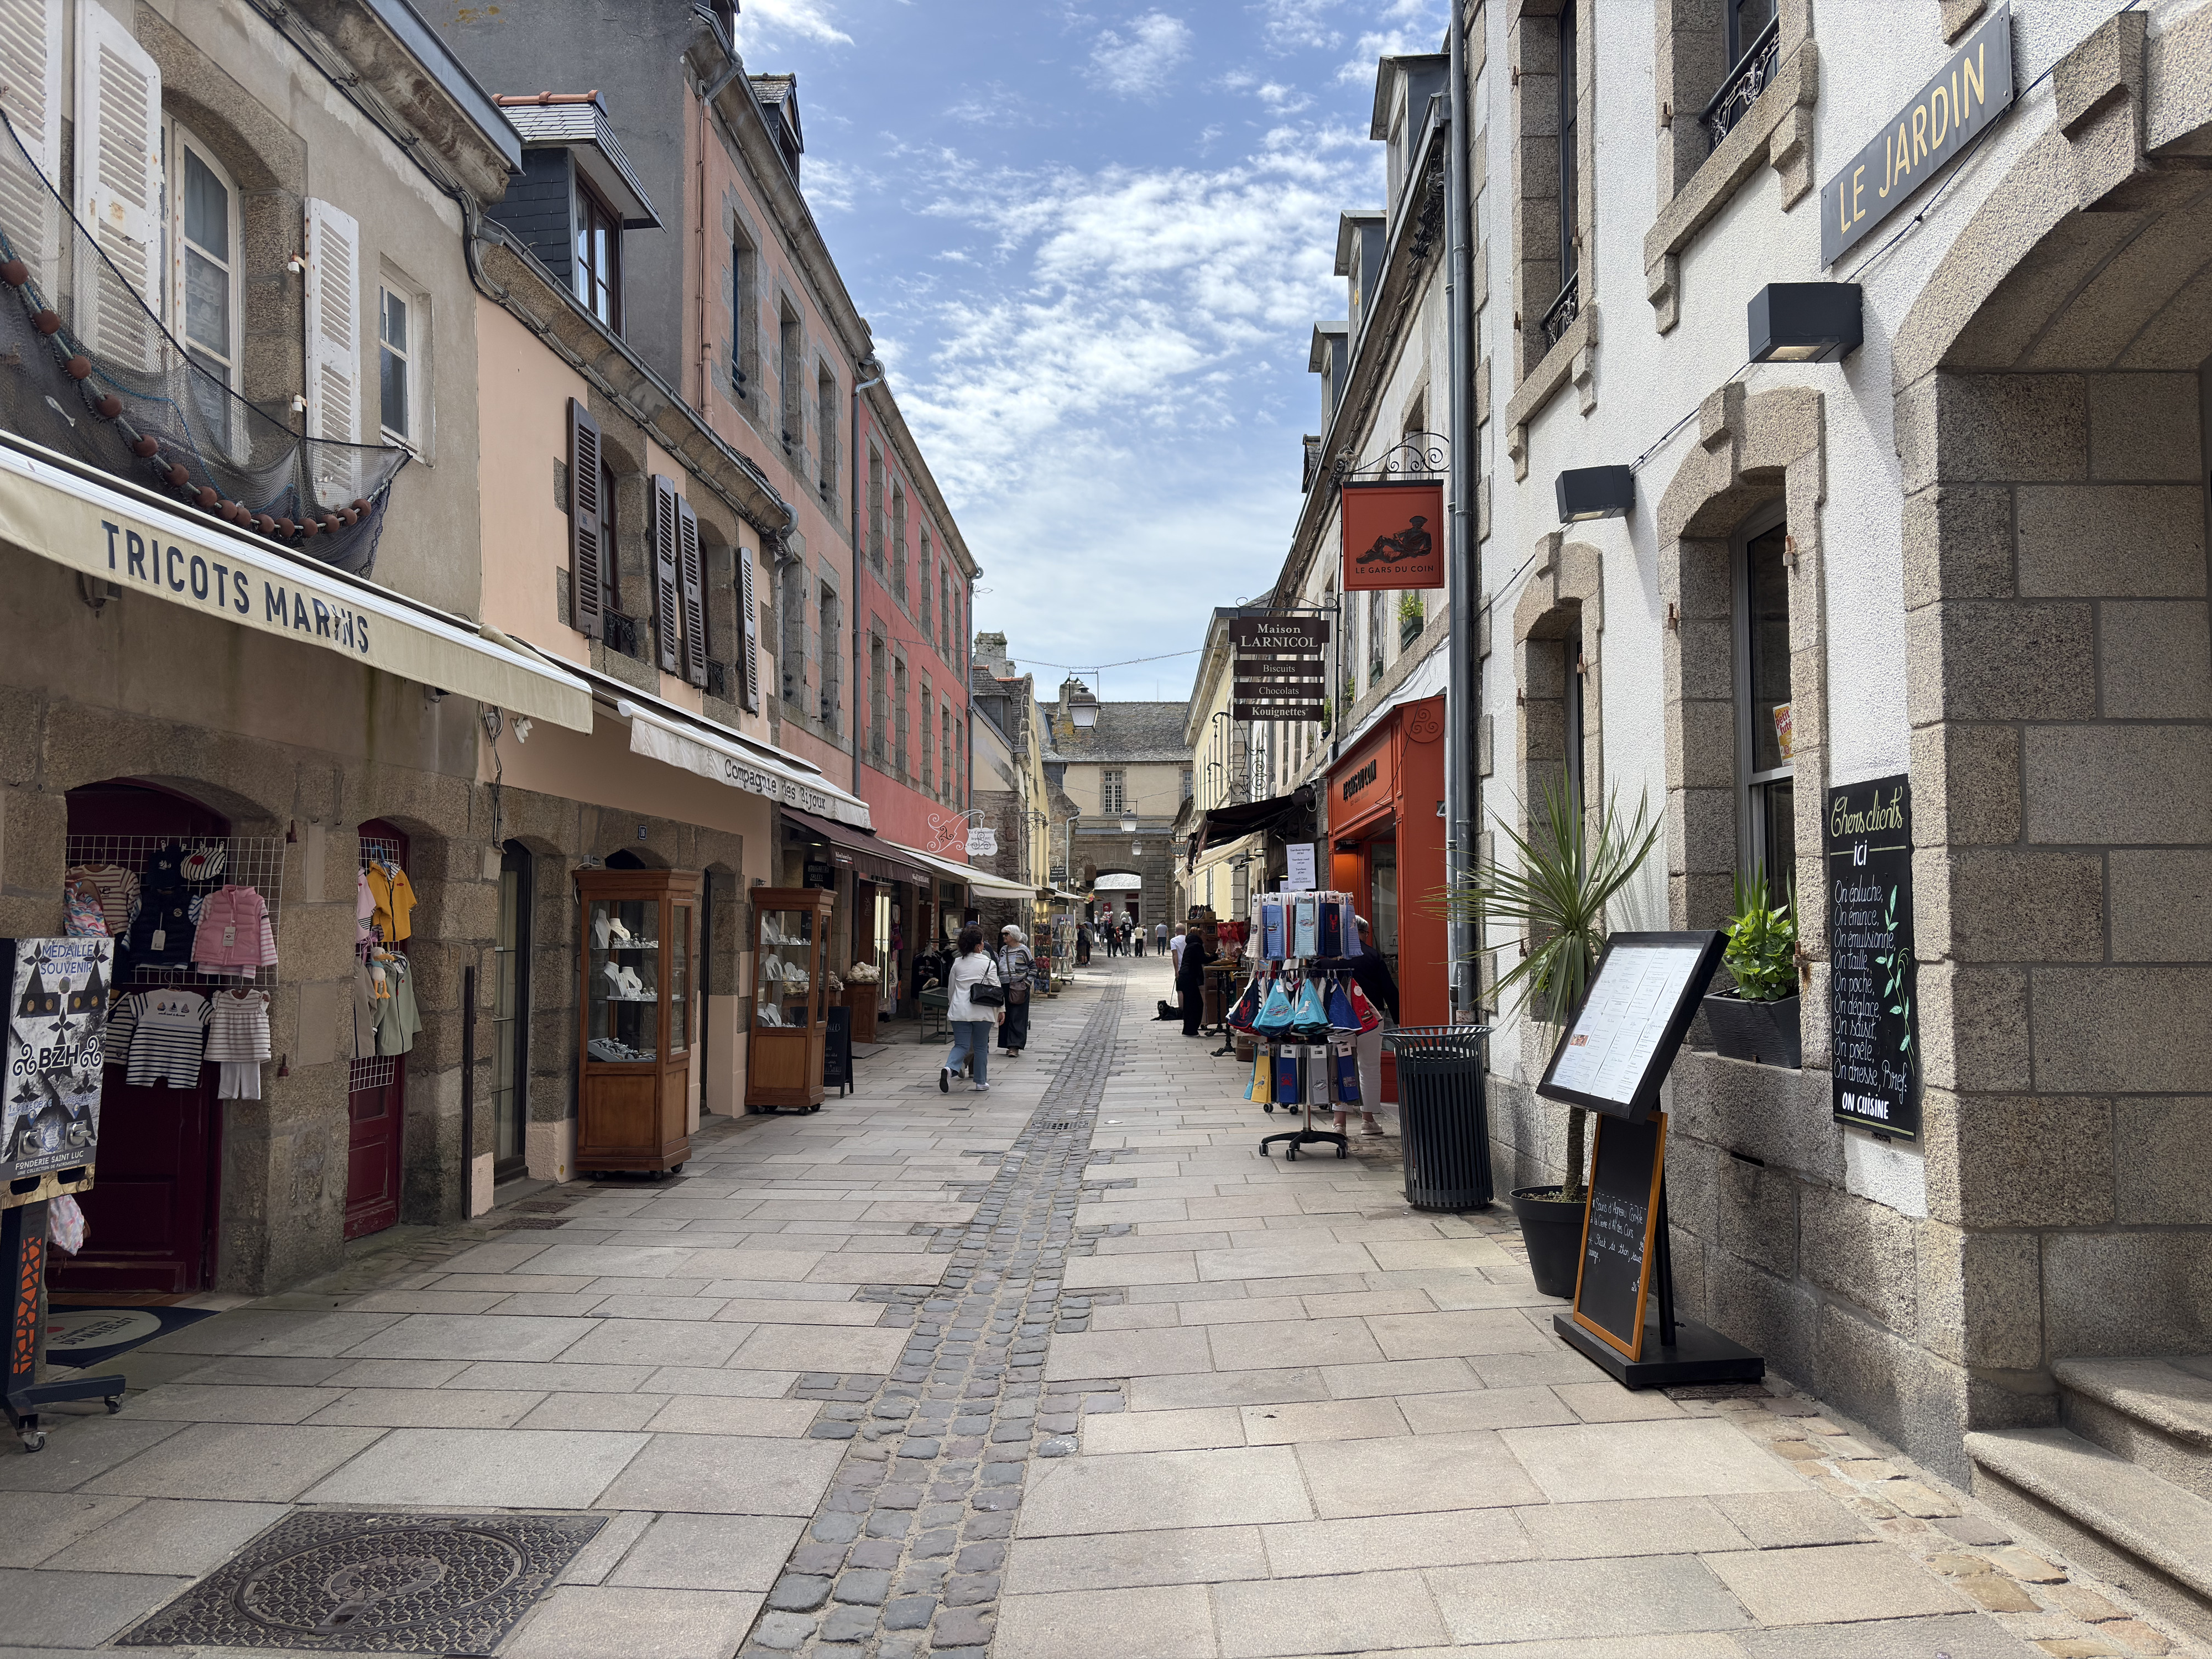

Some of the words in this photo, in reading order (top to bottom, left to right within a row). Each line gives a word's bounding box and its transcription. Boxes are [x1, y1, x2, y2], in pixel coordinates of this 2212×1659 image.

[1840, 164, 1866, 234] LE
[1879, 42, 1985, 199] JARDIN
[101, 519, 251, 614] TRICOTS
[1257, 623, 1301, 634] Maison
[1240, 635, 1318, 648] LARNICOL
[1262, 664, 1296, 672] Biscuits
[1259, 686, 1300, 695] Chocolats
[1775, 709, 1791, 729] petit
[724, 758, 776, 794] Compagnie
[781, 779, 796, 800] des
[800, 786, 826, 810] Bijoux
[1831, 796, 1865, 837] Chers
[1866, 786, 1905, 831] clients
[1835, 880, 1848, 903] On
[1849, 874, 1883, 907] épluche,
[1834, 903, 1846, 926] On
[1848, 906, 1879, 926] émince,
[1834, 927, 1846, 948] On
[1848, 926, 1896, 952] émulsionne,
[40, 961, 93, 975] SOUVENIR
[1834, 949, 1846, 969] On
[1847, 948, 1869, 972] taille,
[1834, 970, 1846, 992] On
[1834, 992, 1846, 1014] On
[1848, 993, 1881, 1022] déglace,
[1834, 1014, 1847, 1035] On
[1849, 1017, 1877, 1041] saisit,
[39, 1044, 79, 1068] BZH
[1834, 1035, 1846, 1057] On
[1849, 1038, 1875, 1063] poêle,
[1834, 1058, 1846, 1079] On
[1848, 1059, 1881, 1092] dresse,
[1842, 1092, 1855, 1112] ON
[15, 1156, 49, 1171] FONDERIE
[51, 1154, 69, 1163] SAINT
[71, 1150, 84, 1159] LUC
[1595, 1197, 1607, 1213] Souris
[1594, 1211, 1598, 1225] la
[1594, 1233, 1606, 1249] Steak
[1609, 1241, 1616, 1251] de
[1631, 1251, 1642, 1264] sauce
[1631, 1281, 1637, 1293] 24
